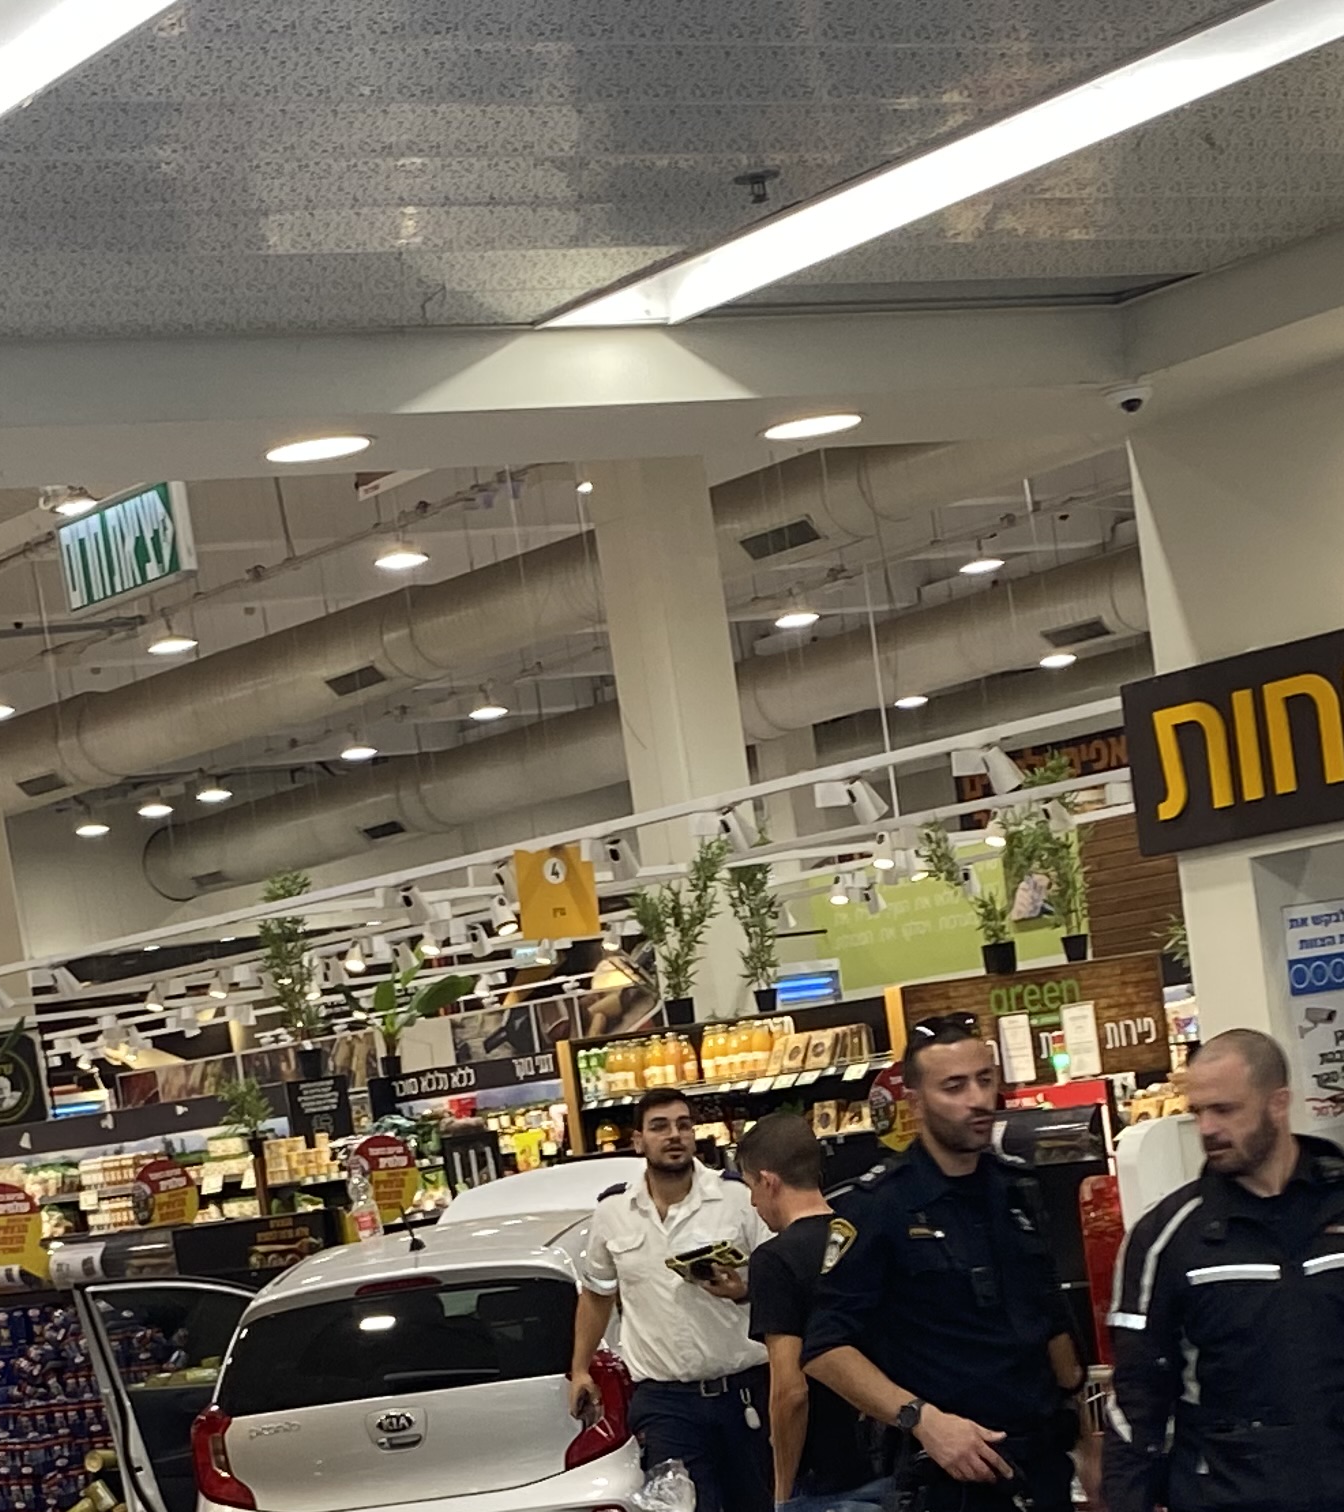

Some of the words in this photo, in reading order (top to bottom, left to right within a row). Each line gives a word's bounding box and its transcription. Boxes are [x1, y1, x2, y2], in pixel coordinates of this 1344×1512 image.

[550, 861, 560, 879] 4
[1288, 916, 1309, 930] את
[1103, 1016, 1157, 1050] פירות
[450, 1066, 476, 1088] ללא
[379, 1414, 412, 1431] KIA
